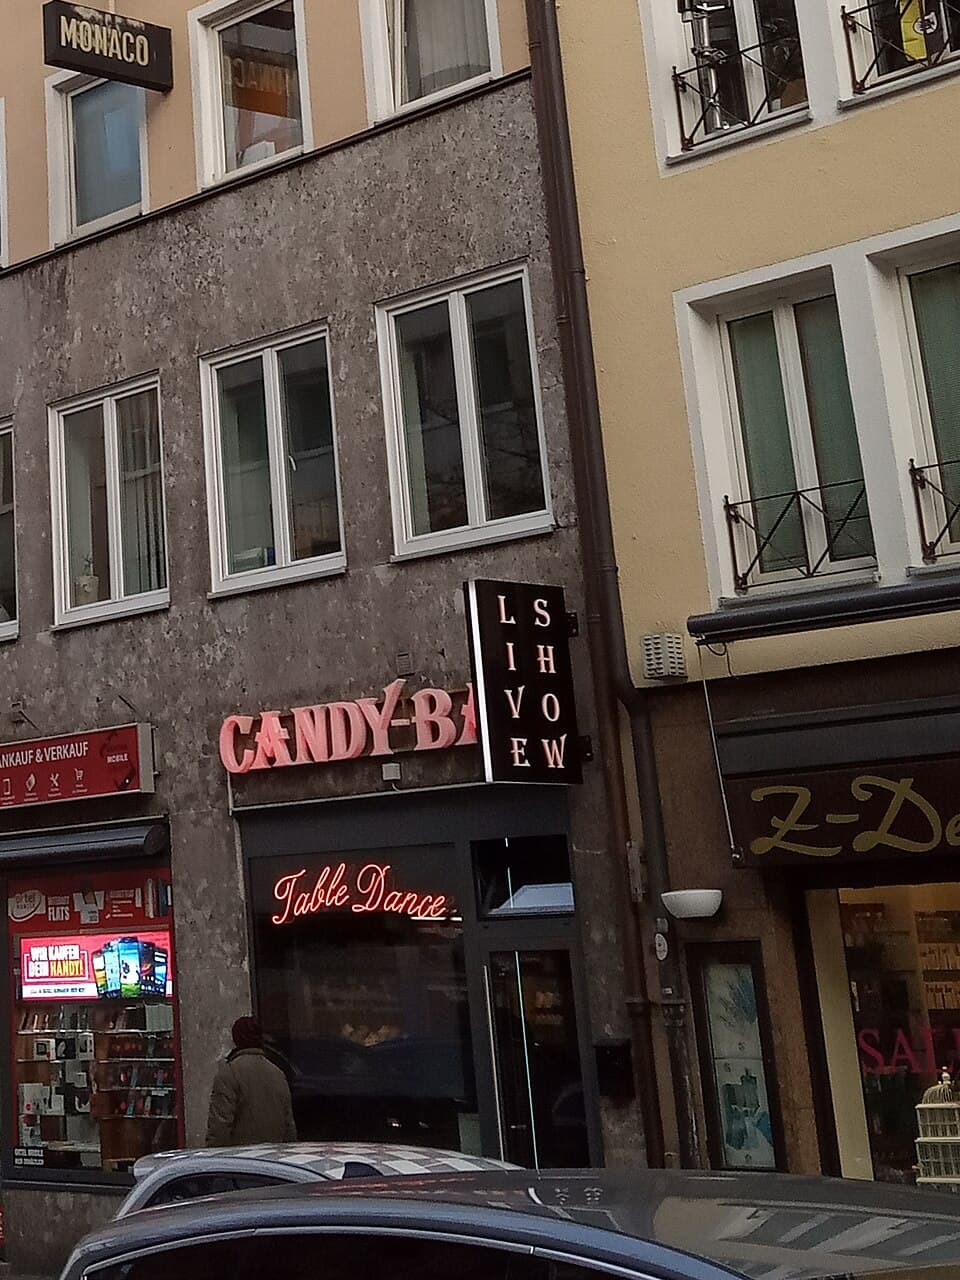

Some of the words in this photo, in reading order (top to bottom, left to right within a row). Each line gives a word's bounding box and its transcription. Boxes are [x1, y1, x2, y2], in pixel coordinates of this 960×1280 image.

[60, 15, 150, 67] MONACO
[496, 595, 531, 768] LIVE
[533, 599, 567, 769] SHOW
[35, 750, 43, 763] &
[44, 741, 89, 761] VERKAUF
[47, 905, 70, 921] FLATS
[271, 863, 350, 925] Table
[351, 863, 448, 919] Dance
[49, 959, 83, 977] HANDY!
